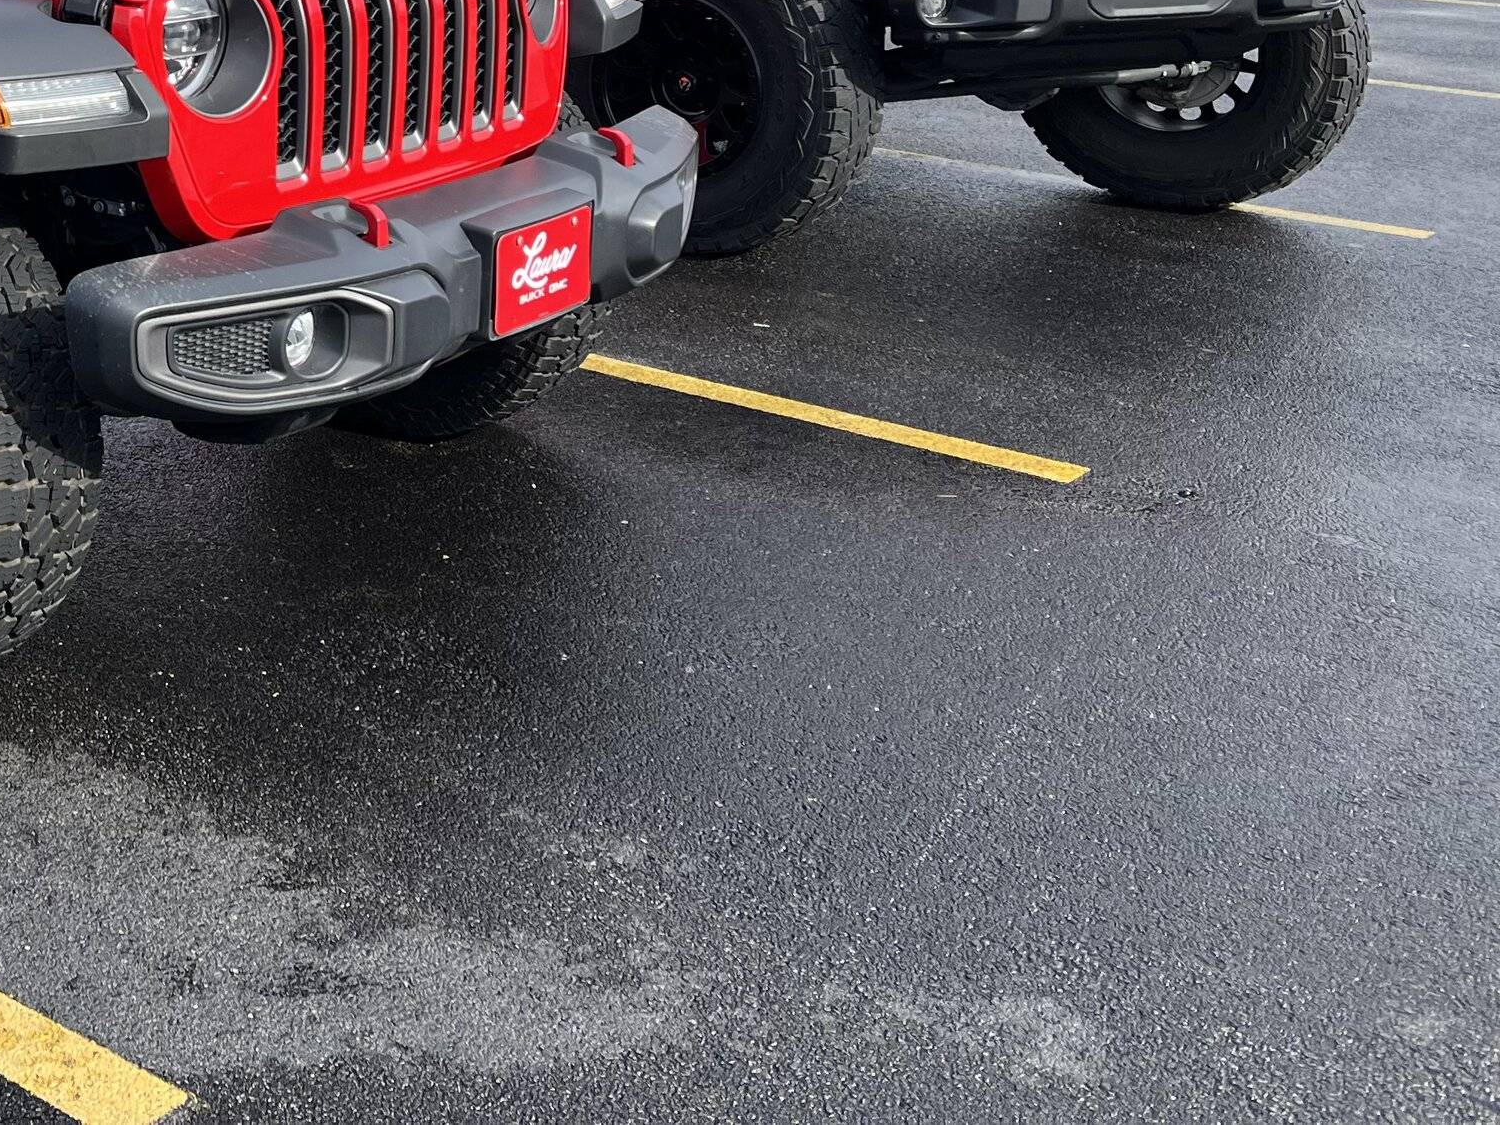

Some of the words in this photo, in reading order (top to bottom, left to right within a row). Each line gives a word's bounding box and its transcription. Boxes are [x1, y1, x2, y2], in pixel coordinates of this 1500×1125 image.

[511, 231, 578, 290] Laura
[519, 289, 545, 304] BUICK
[548, 278, 569, 294] GMC
